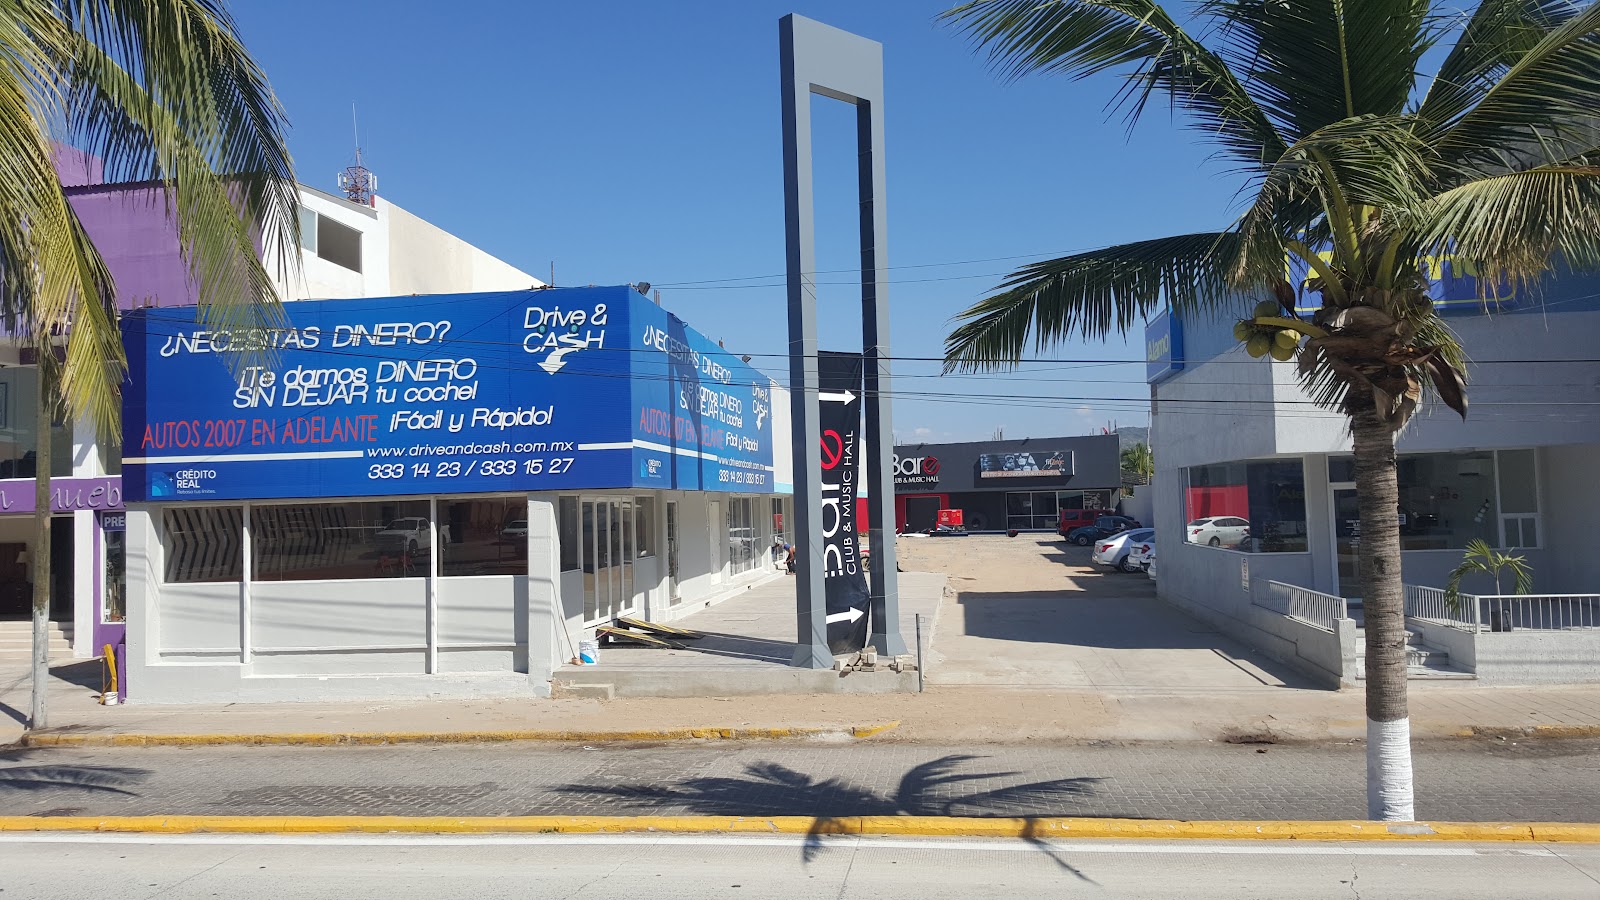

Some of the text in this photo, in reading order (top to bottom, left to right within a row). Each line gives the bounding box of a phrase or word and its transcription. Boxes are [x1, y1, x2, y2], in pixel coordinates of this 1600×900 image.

[524, 303, 608, 329] Drive &
[160, 320, 451, 357] ¿NECESITAS DINERO?
[1148, 333, 1169, 362] Alamo
[643, 325, 732, 384] ¿NECESITAS DINERO?
[283, 365, 367, 386] damos
[376, 358, 477, 383] DINERO
[233, 381, 478, 408] SIN DEJAR tu coche!
[719, 391, 743, 414] DINERO
[141, 415, 378, 449] AUTOS 2007 EN ADELANTE
[389, 405, 554, 433] ¡Fácil y Rápido!
[640, 406, 667, 437] AUTOS
[667, 413, 685, 441] 207
[367, 440, 574, 458] www.driveandcash.com.mx
[176, 469, 216, 479] CRÉDITO
[368, 458, 575, 479] 333 14 23 / 333 15 27
[893, 453, 941, 475] Bare
[176, 480, 200, 488] REAL
[842, 430, 857, 575] CLUB & MUSIC HALL
[104, 515, 126, 528] PRE
